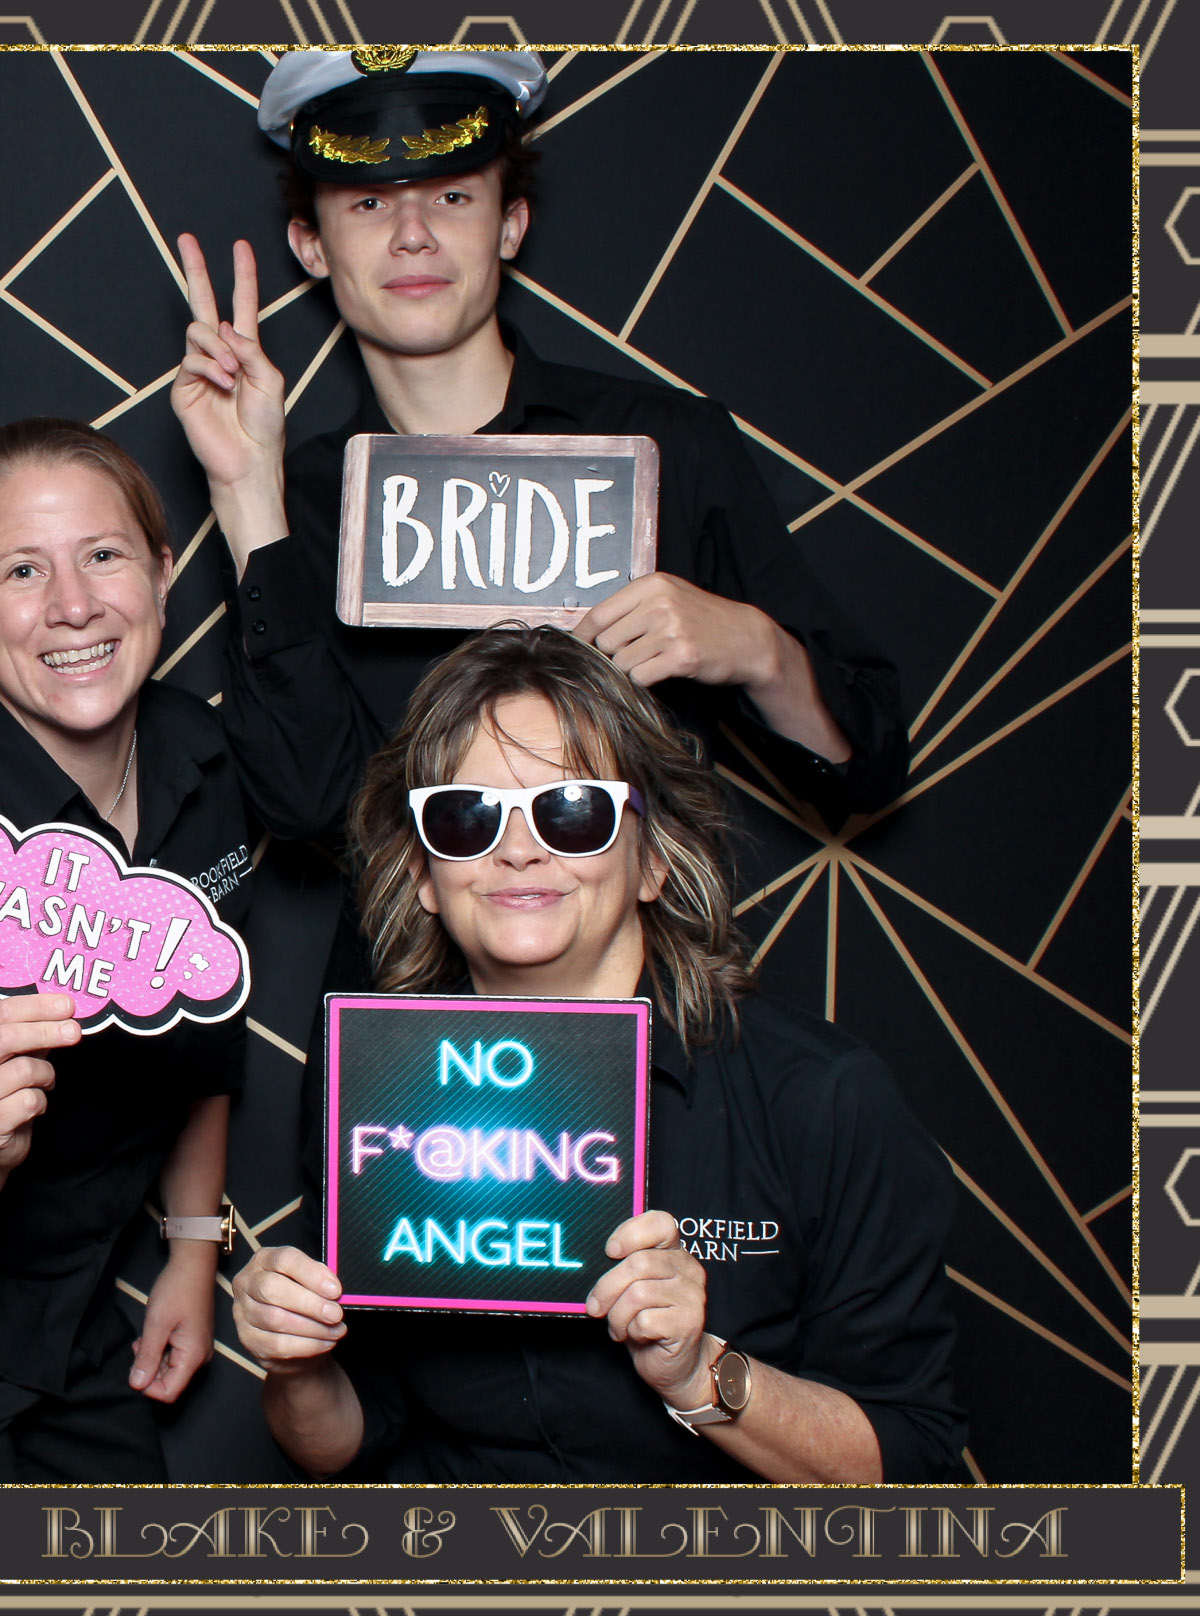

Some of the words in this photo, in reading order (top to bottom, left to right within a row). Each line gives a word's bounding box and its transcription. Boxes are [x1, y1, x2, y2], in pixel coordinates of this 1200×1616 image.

[42, 847, 91, 892] IT
[190, 844, 249, 889] ROOKFIELD
[40, 948, 115, 999] ME
[438, 1038, 535, 1089] NO
[382, 1216, 585, 1270] ANGEL
